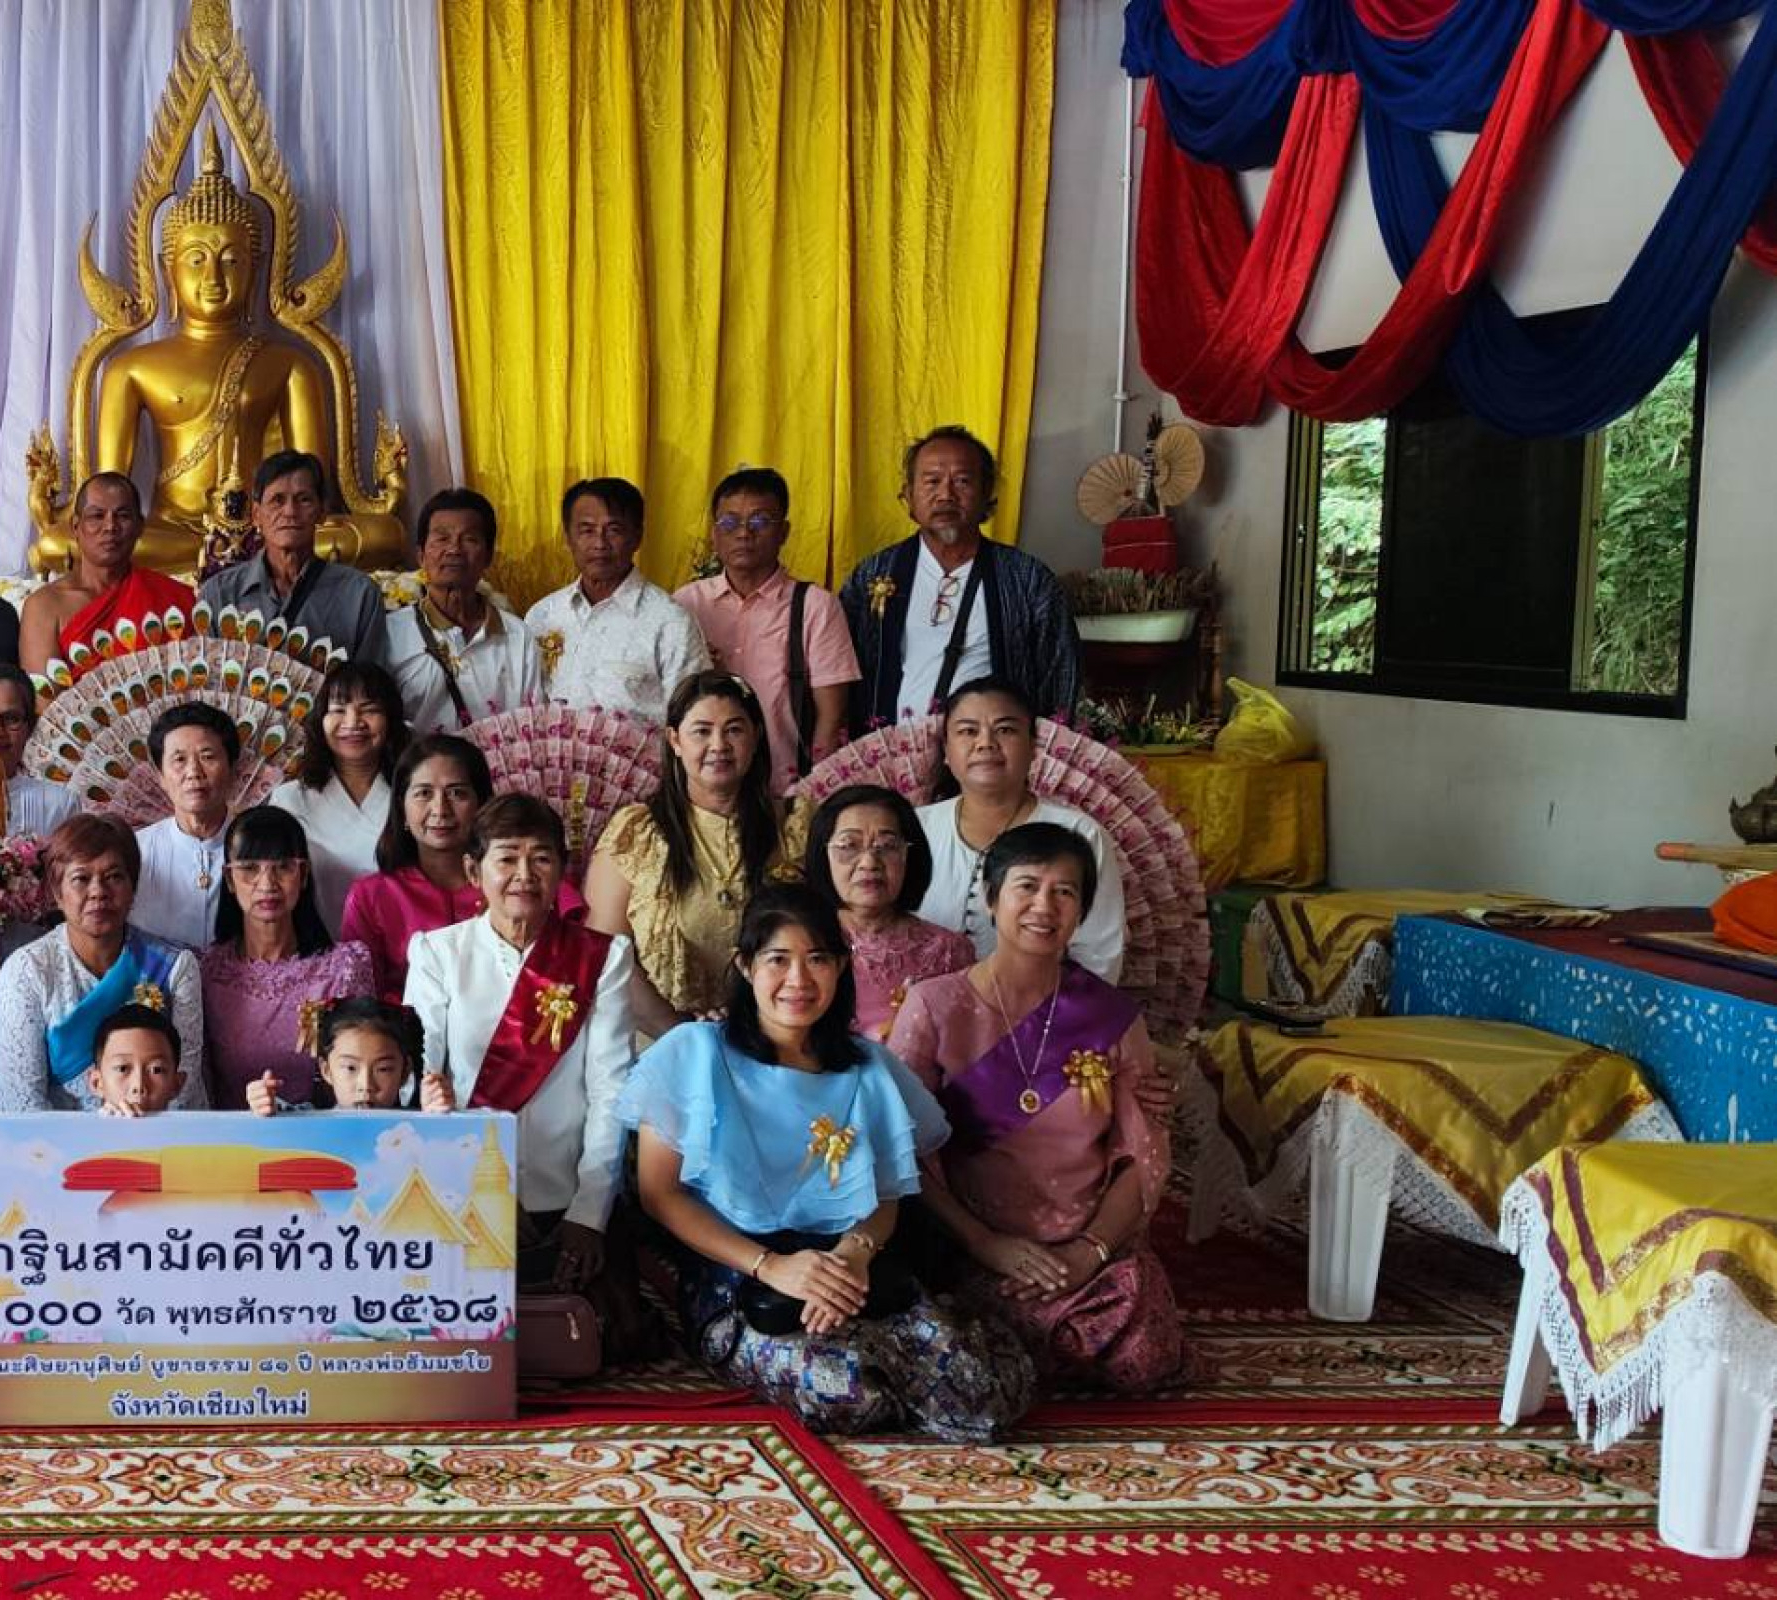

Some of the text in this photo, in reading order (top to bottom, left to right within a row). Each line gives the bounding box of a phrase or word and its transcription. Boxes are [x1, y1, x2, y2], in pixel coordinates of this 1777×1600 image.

[116, 1297, 156, 1325] วัด
[165, 1296, 338, 1335] พุทธศักราช
[351, 1293, 499, 1324] ๒๕๖๘
[150, 1358, 252, 1381] บูชาธรรม
[258, 1358, 290, 1373] ๘๑
[296, 1351, 314, 1373] ปี
[110, 1387, 309, 1418] จังหวัดเชียงใหม่
